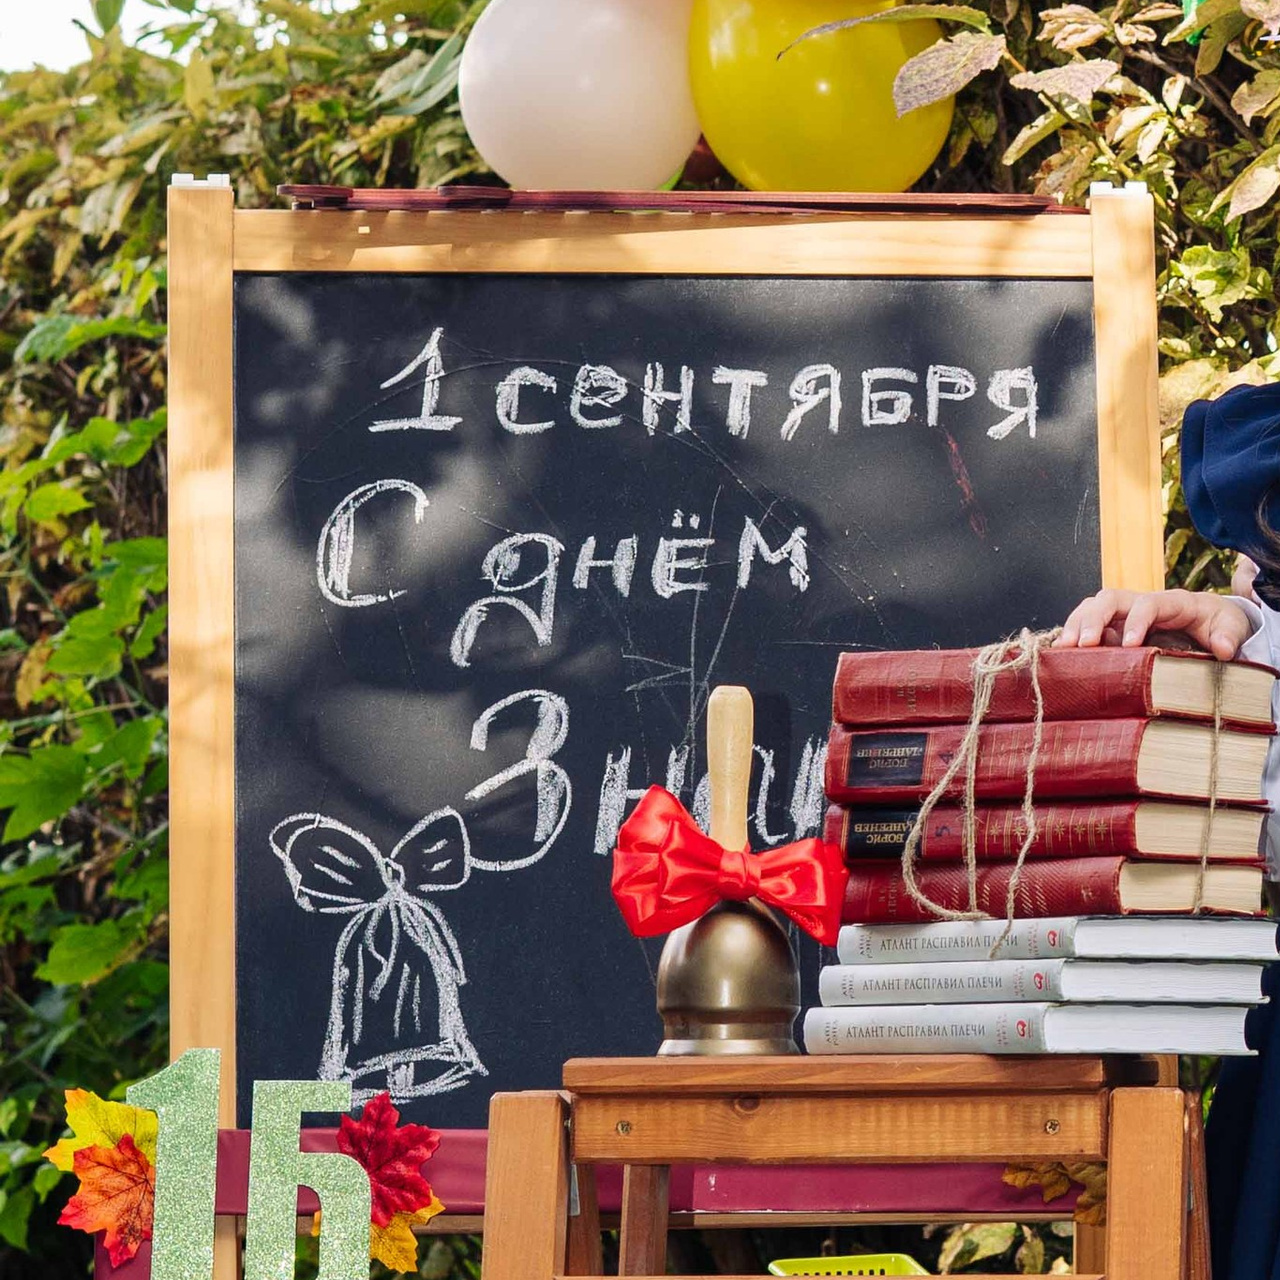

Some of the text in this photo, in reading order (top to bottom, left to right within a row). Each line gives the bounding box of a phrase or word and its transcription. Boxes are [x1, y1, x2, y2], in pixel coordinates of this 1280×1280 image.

[368, 326, 463, 432] 1
[866, 833, 905, 844] БОРИС
[881, 934, 1018, 951] АТЛАНТ РАСПРАВИЛ ПЛЧИ
[862, 976, 1002, 991] АТЛАНТ РАСПРАВИЛ ПЛЕЧИ
[846, 1024, 985, 1039] АТЛАНТ РАСПРАВИЛ ПЛЕЧИ
